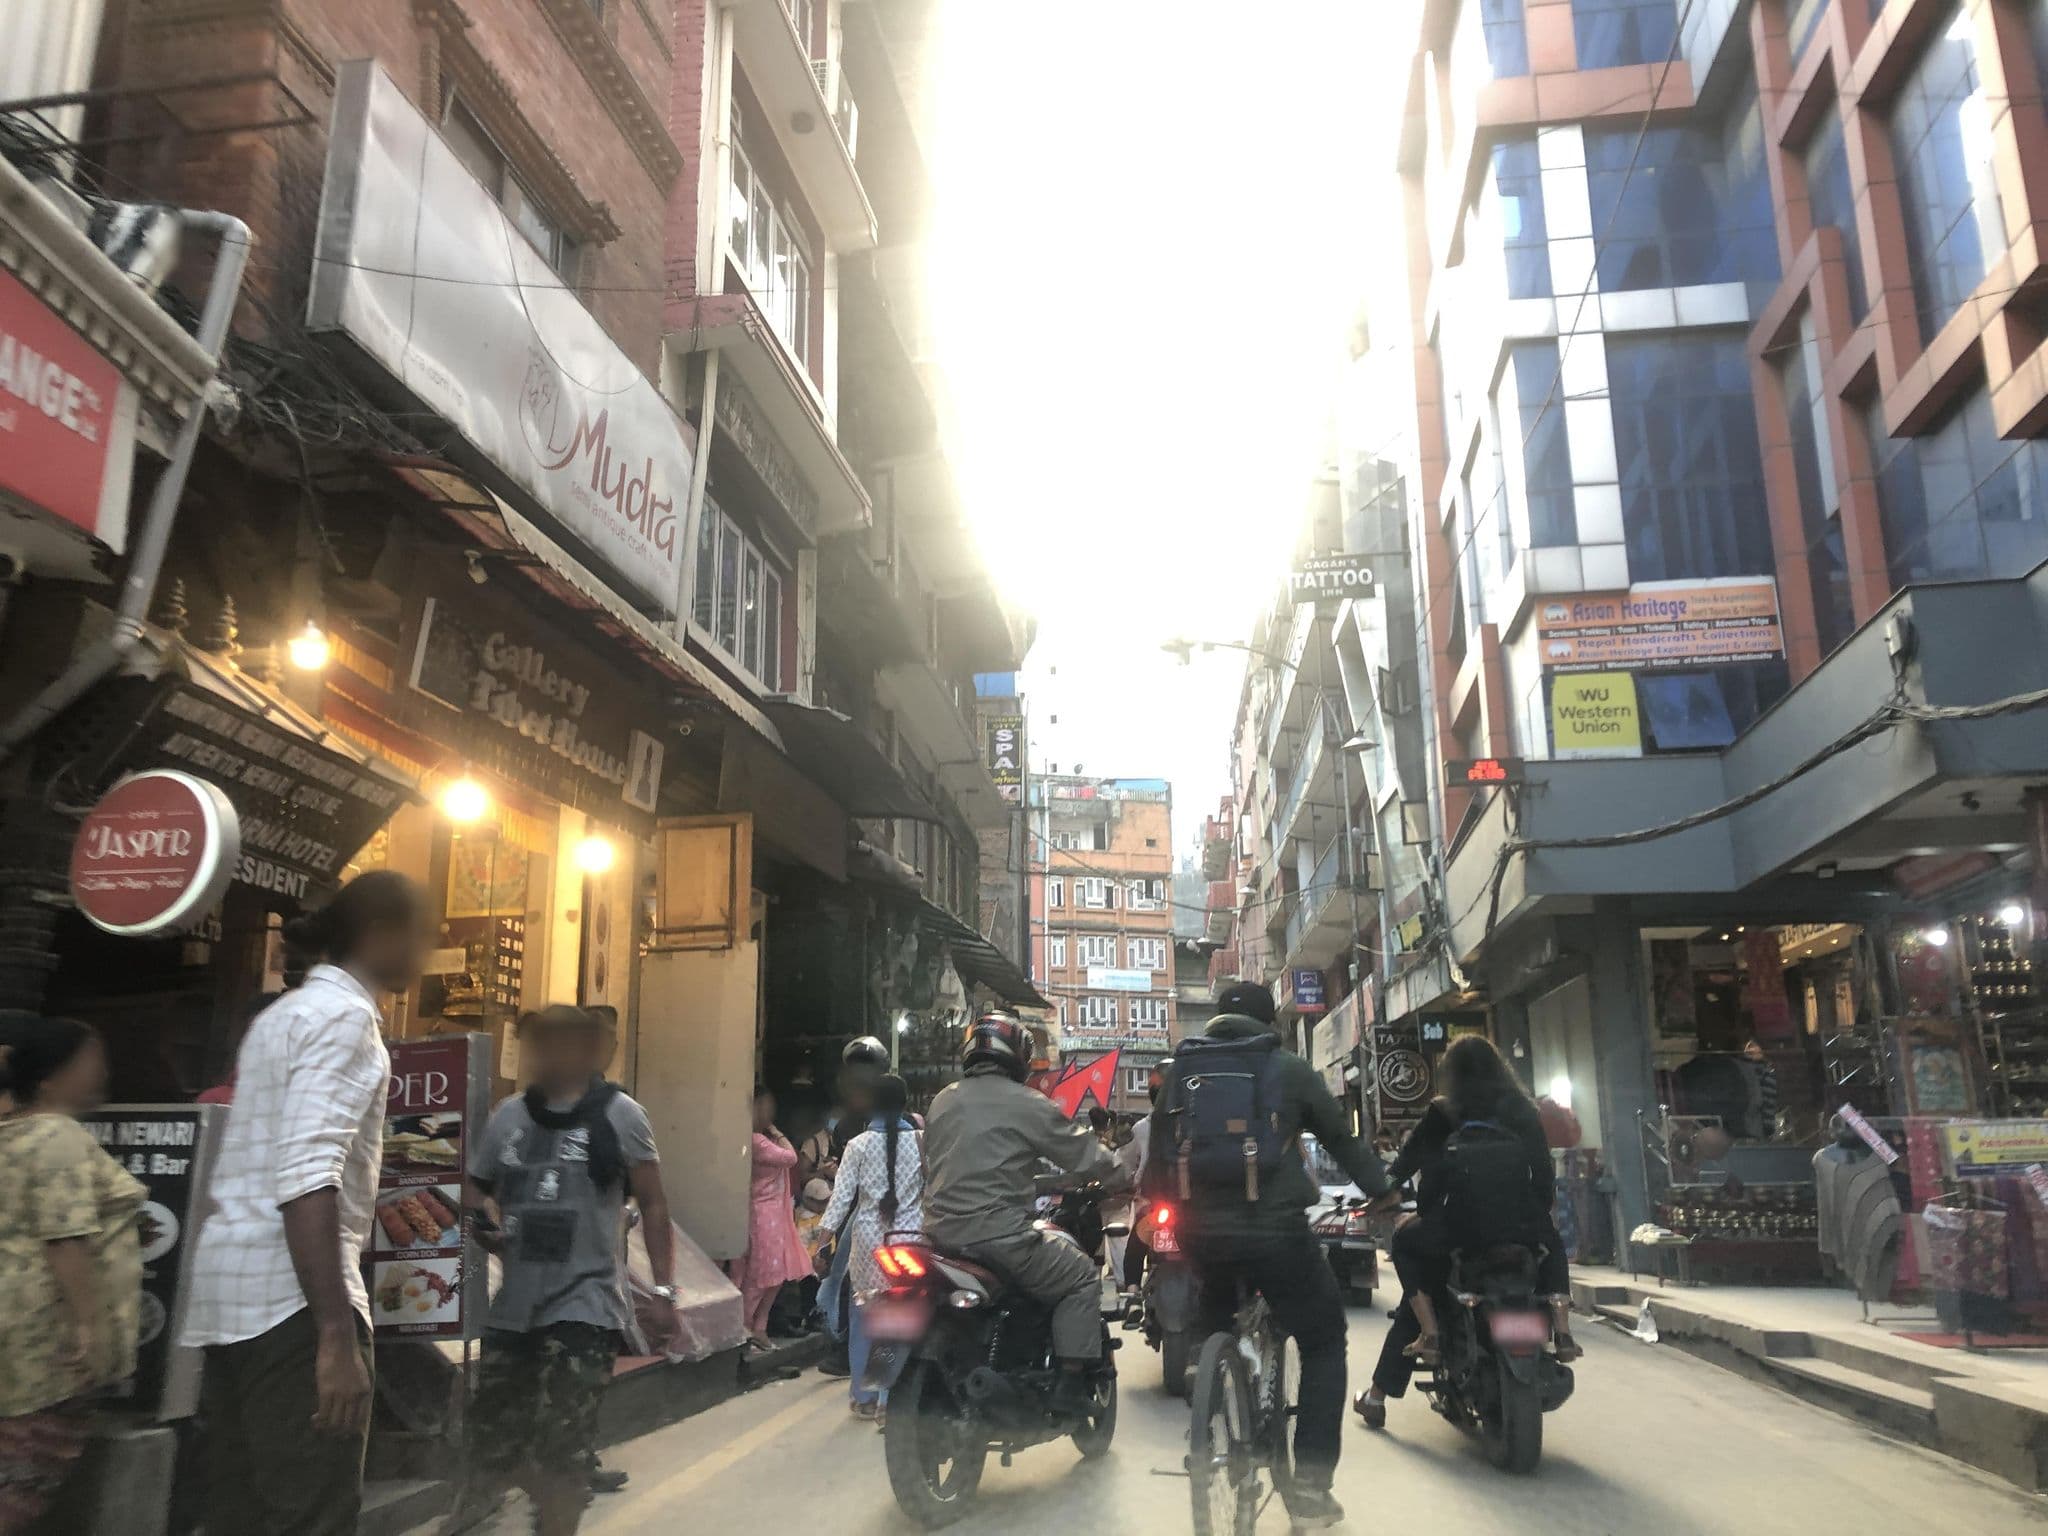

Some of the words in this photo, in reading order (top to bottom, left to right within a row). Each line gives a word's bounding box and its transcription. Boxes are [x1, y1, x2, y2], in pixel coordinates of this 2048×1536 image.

[556, 405, 678, 562] Mudra
[1291, 568, 1373, 589] TATTOO
[1573, 603, 1615, 620] Asian
[1621, 598, 1687, 620] Heritage
[1578, 639, 1616, 649] Nepal
[1622, 633, 1697, 645] Handicrafts
[1702, 629, 1772, 640] Collections
[481, 632, 590, 718] Gallery
[1577, 688, 1609, 702] WU
[1558, 705, 1632, 720] Western
[1572, 719, 1621, 734] Union
[993, 729, 1014, 769] SPA
[86, 825, 192, 860] JASPER
[277, 831, 340, 873] HOTEL
[1423, 1022, 1443, 1040] Sub
[118, 1121, 195, 1146] NEWARI
[149, 1153, 190, 1175] Bar
[399, 1175, 439, 1186] SANDWICH
